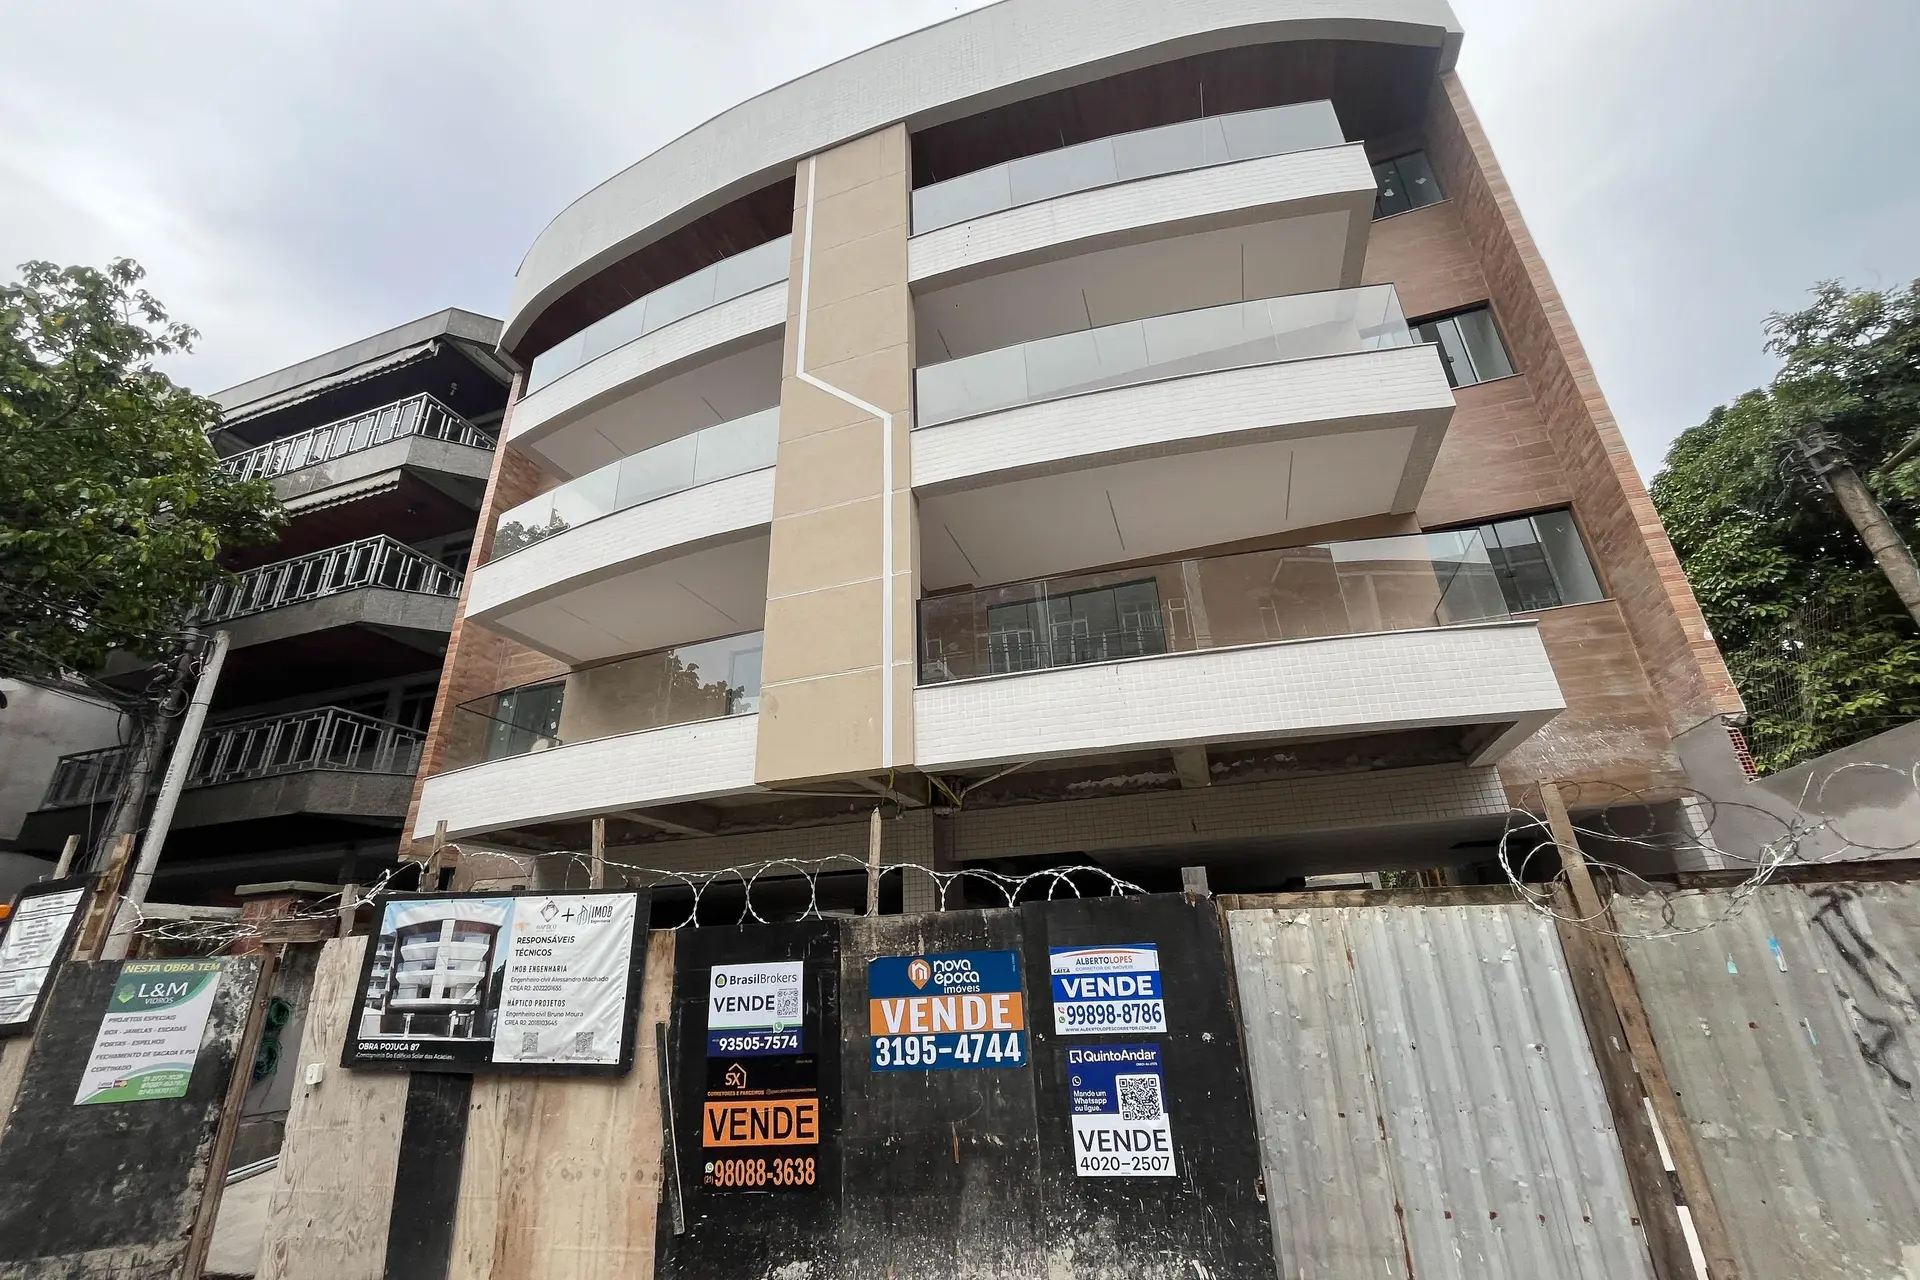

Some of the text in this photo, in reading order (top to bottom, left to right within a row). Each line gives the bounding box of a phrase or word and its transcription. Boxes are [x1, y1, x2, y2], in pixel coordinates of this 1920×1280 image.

[591, 905, 613, 918] IMOB
[516, 936, 576, 945] RESPONSÁVEIS
[515, 948, 552, 957] TÉCNICOS
[933, 959, 971, 972] nova
[1075, 955, 1133, 966] ALBERTOLOPES
[124, 962, 220, 973] NESTA OBRA TEM
[511, 965, 568, 973] IMOB ENGENHARIA
[729, 973, 797, 985] BrasilBrokers
[934, 970, 980, 987] época
[138, 982, 189, 998] L&M
[943, 984, 981, 994] imóveis
[1061, 975, 1154, 998] VENDE
[145, 997, 175, 1005] VIDROS
[507, 998, 566, 1007] HÁPTICO PROJETOS
[713, 995, 775, 1013] VENDE
[881, 994, 1012, 1034] VENDE
[1066, 1003, 1162, 1026] 99898-8786
[380, 1043, 409, 1051] POJUCA
[410, 1043, 420, 1051] 87
[719, 1035, 798, 1051] 93505-7574
[875, 1032, 1022, 1067] 3195-4744
[1083, 1049, 1157, 1062] QuintoAndar
[725, 1072, 741, 1086] SX
[1074, 1097, 1107, 1106] Whatsapp
[1084, 1105, 1102, 1113] ligue.
[708, 1105, 815, 1141] VENDE
[1078, 1129, 1169, 1152] VENDE
[1080, 1156, 1170, 1171] 4020-2507
[714, 1157, 816, 1187] 98088-3638
